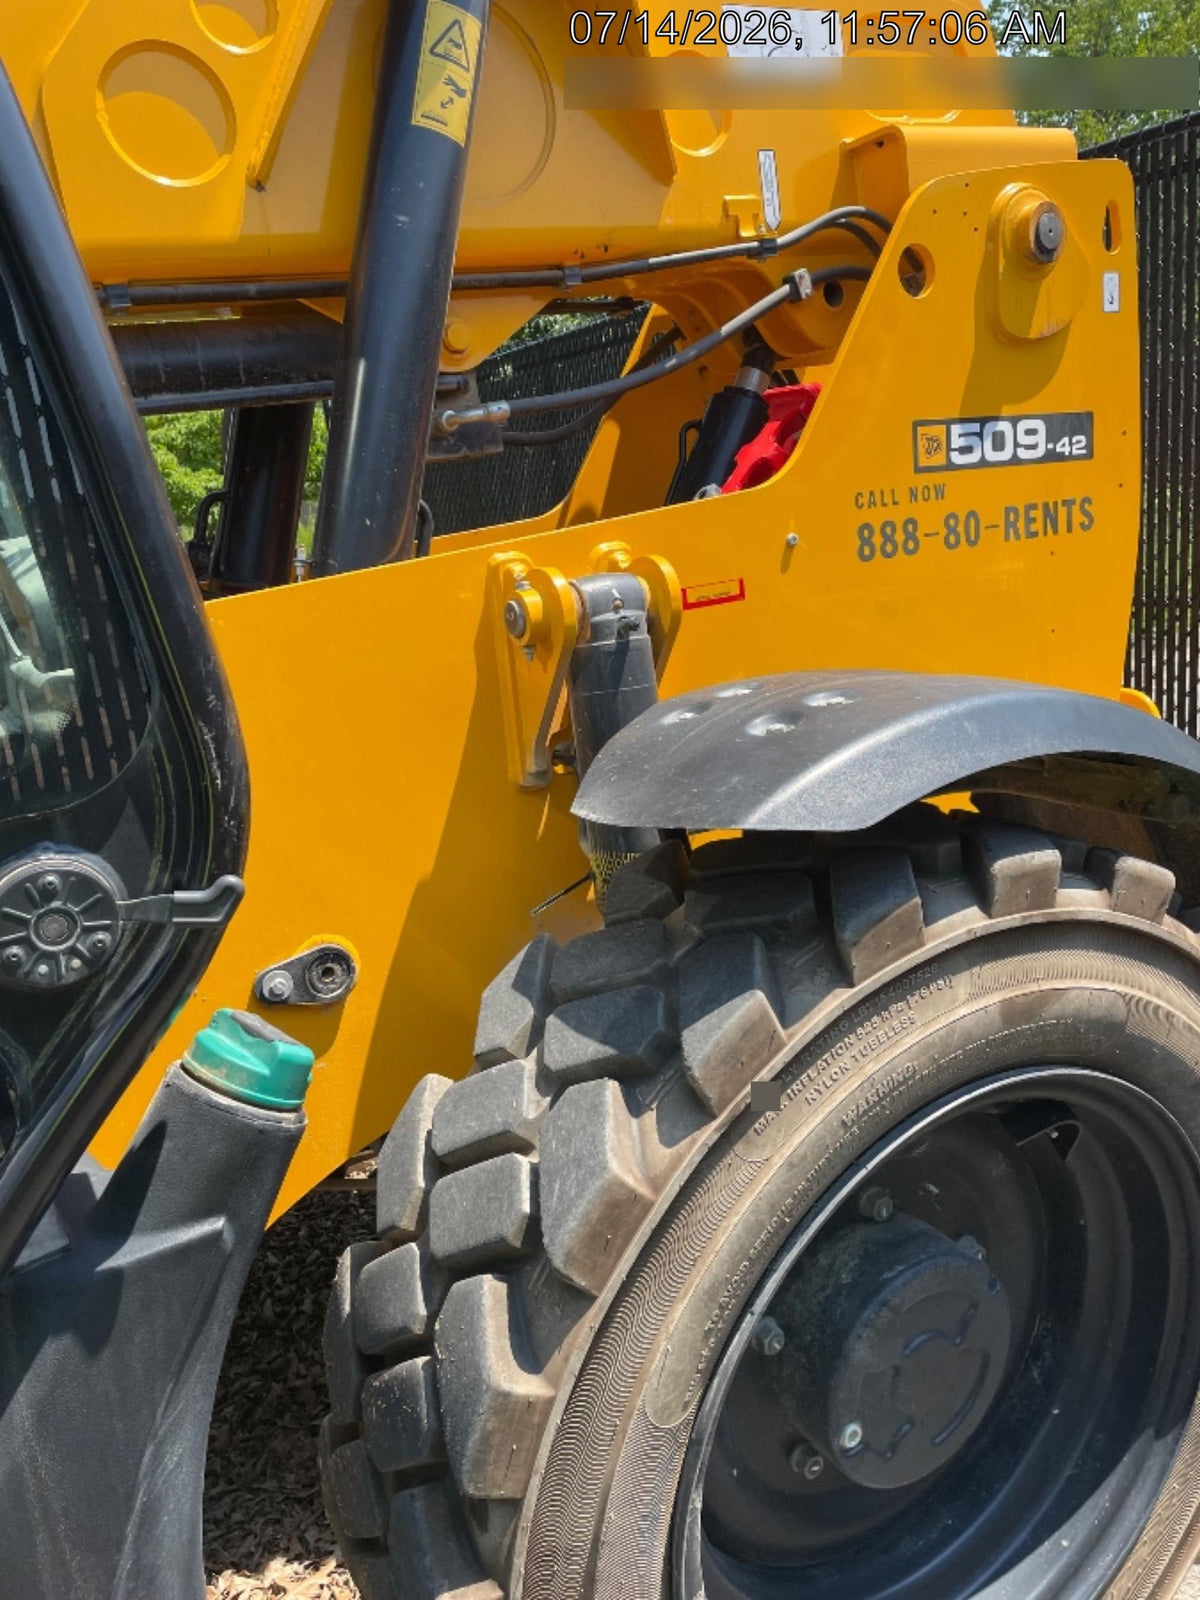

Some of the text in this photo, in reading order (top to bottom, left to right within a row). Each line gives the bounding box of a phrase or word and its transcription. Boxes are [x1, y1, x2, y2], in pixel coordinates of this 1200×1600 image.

[950, 419, 1088, 465] 509-42
[855, 483, 947, 509] CALL NOW
[857, 496, 1095, 562] 888-80-RENTS
[786, 1035, 856, 1100] INFLATION
[802, 1059, 853, 1106] NYLON
[851, 1010, 918, 1063] TUBELESS
[805, 1019, 851, 1062] RATING
